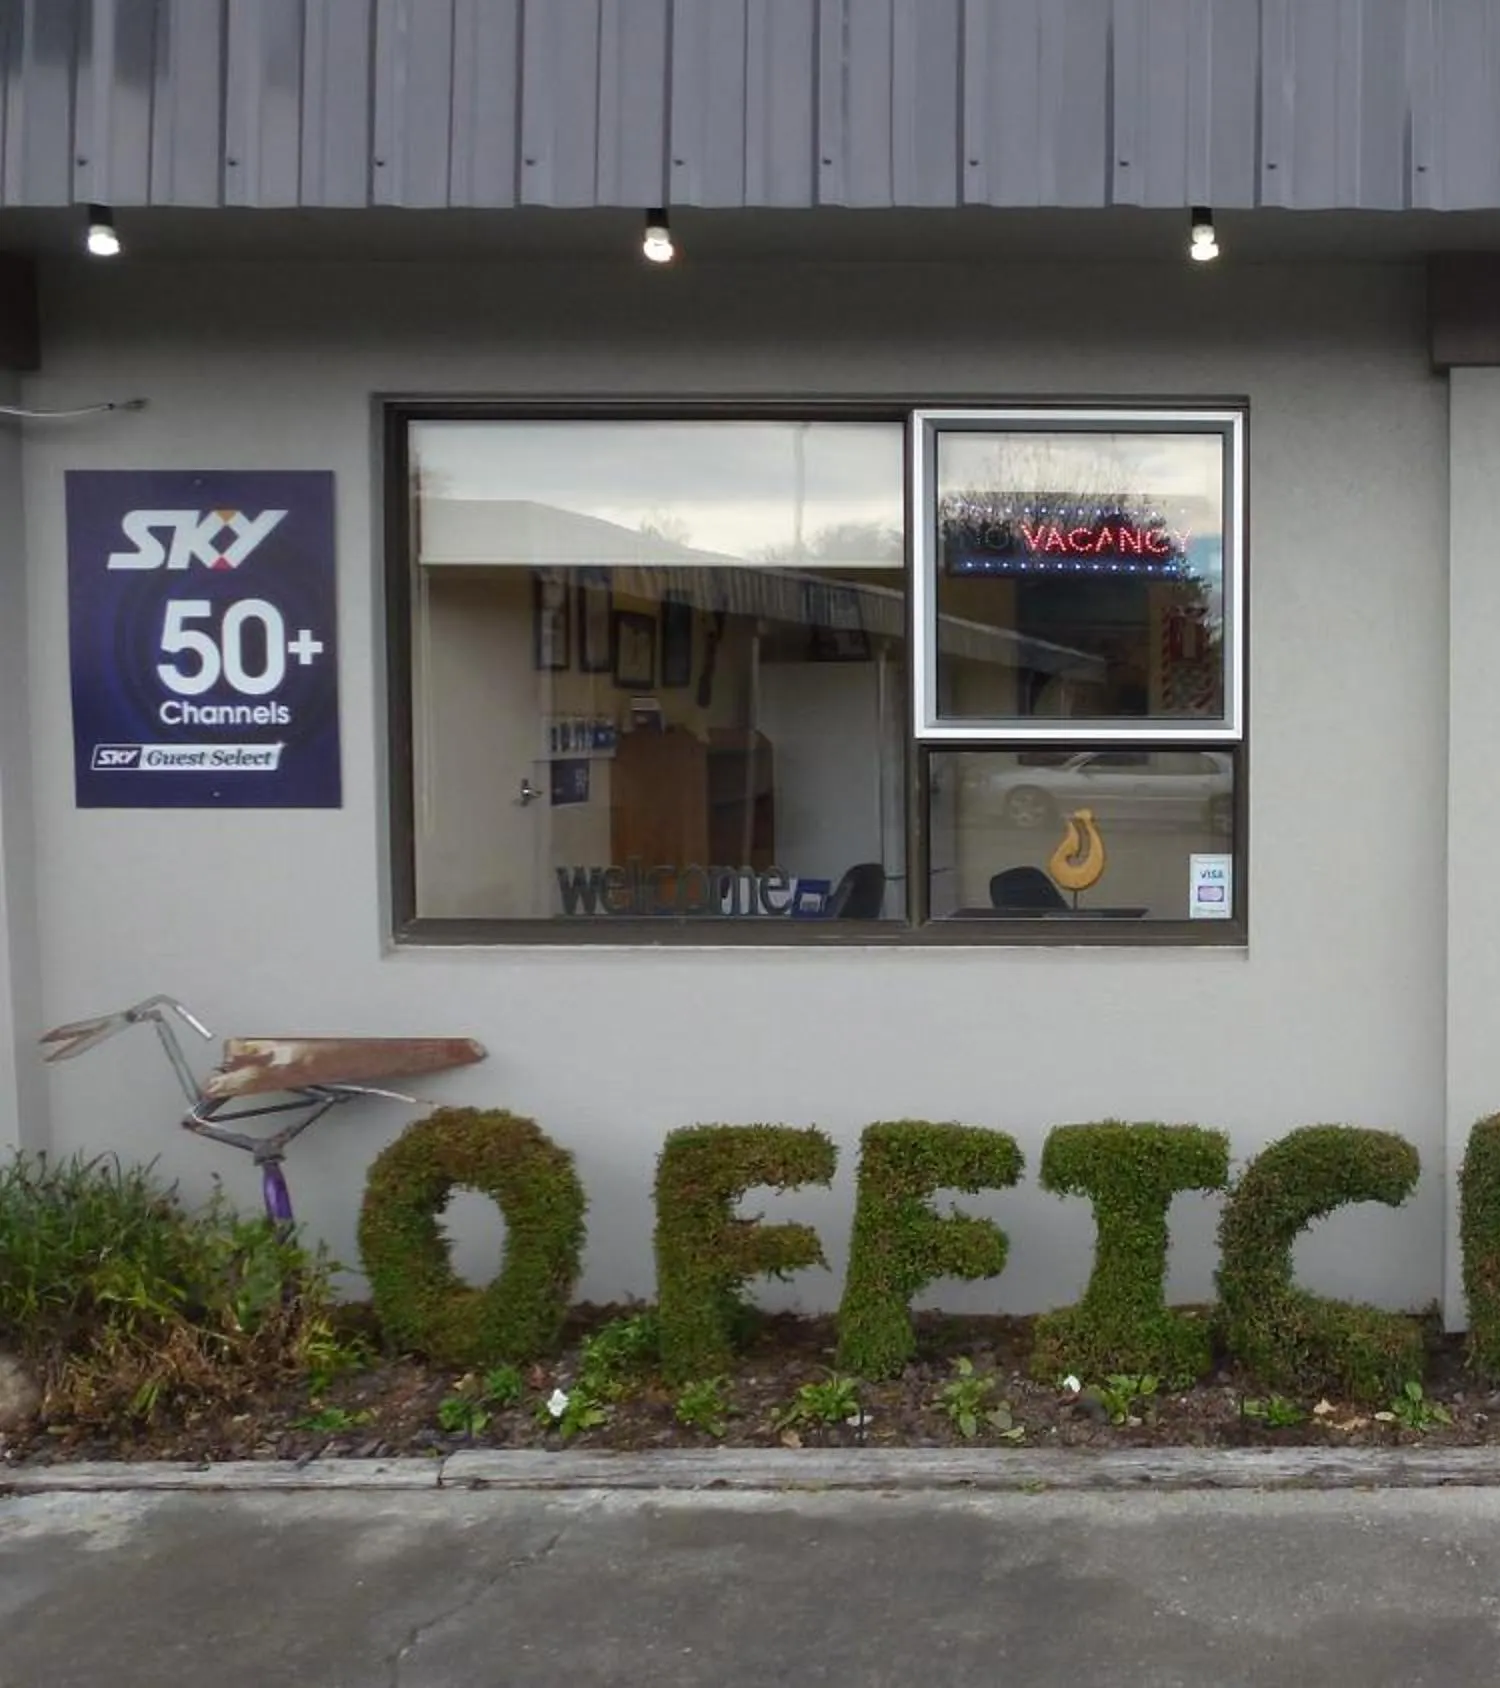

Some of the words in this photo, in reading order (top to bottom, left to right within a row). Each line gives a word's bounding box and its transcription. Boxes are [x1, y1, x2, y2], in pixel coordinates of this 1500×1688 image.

[106, 508, 289, 570] SKY
[1020, 523, 1193, 554] VACANCY
[156, 598, 323, 695] 50+
[159, 700, 291, 725] Channels
[97, 750, 139, 765] SKY
[146, 749, 205, 767] Guest
[210, 748, 272, 767] Select
[555, 856, 792, 916] welcome
